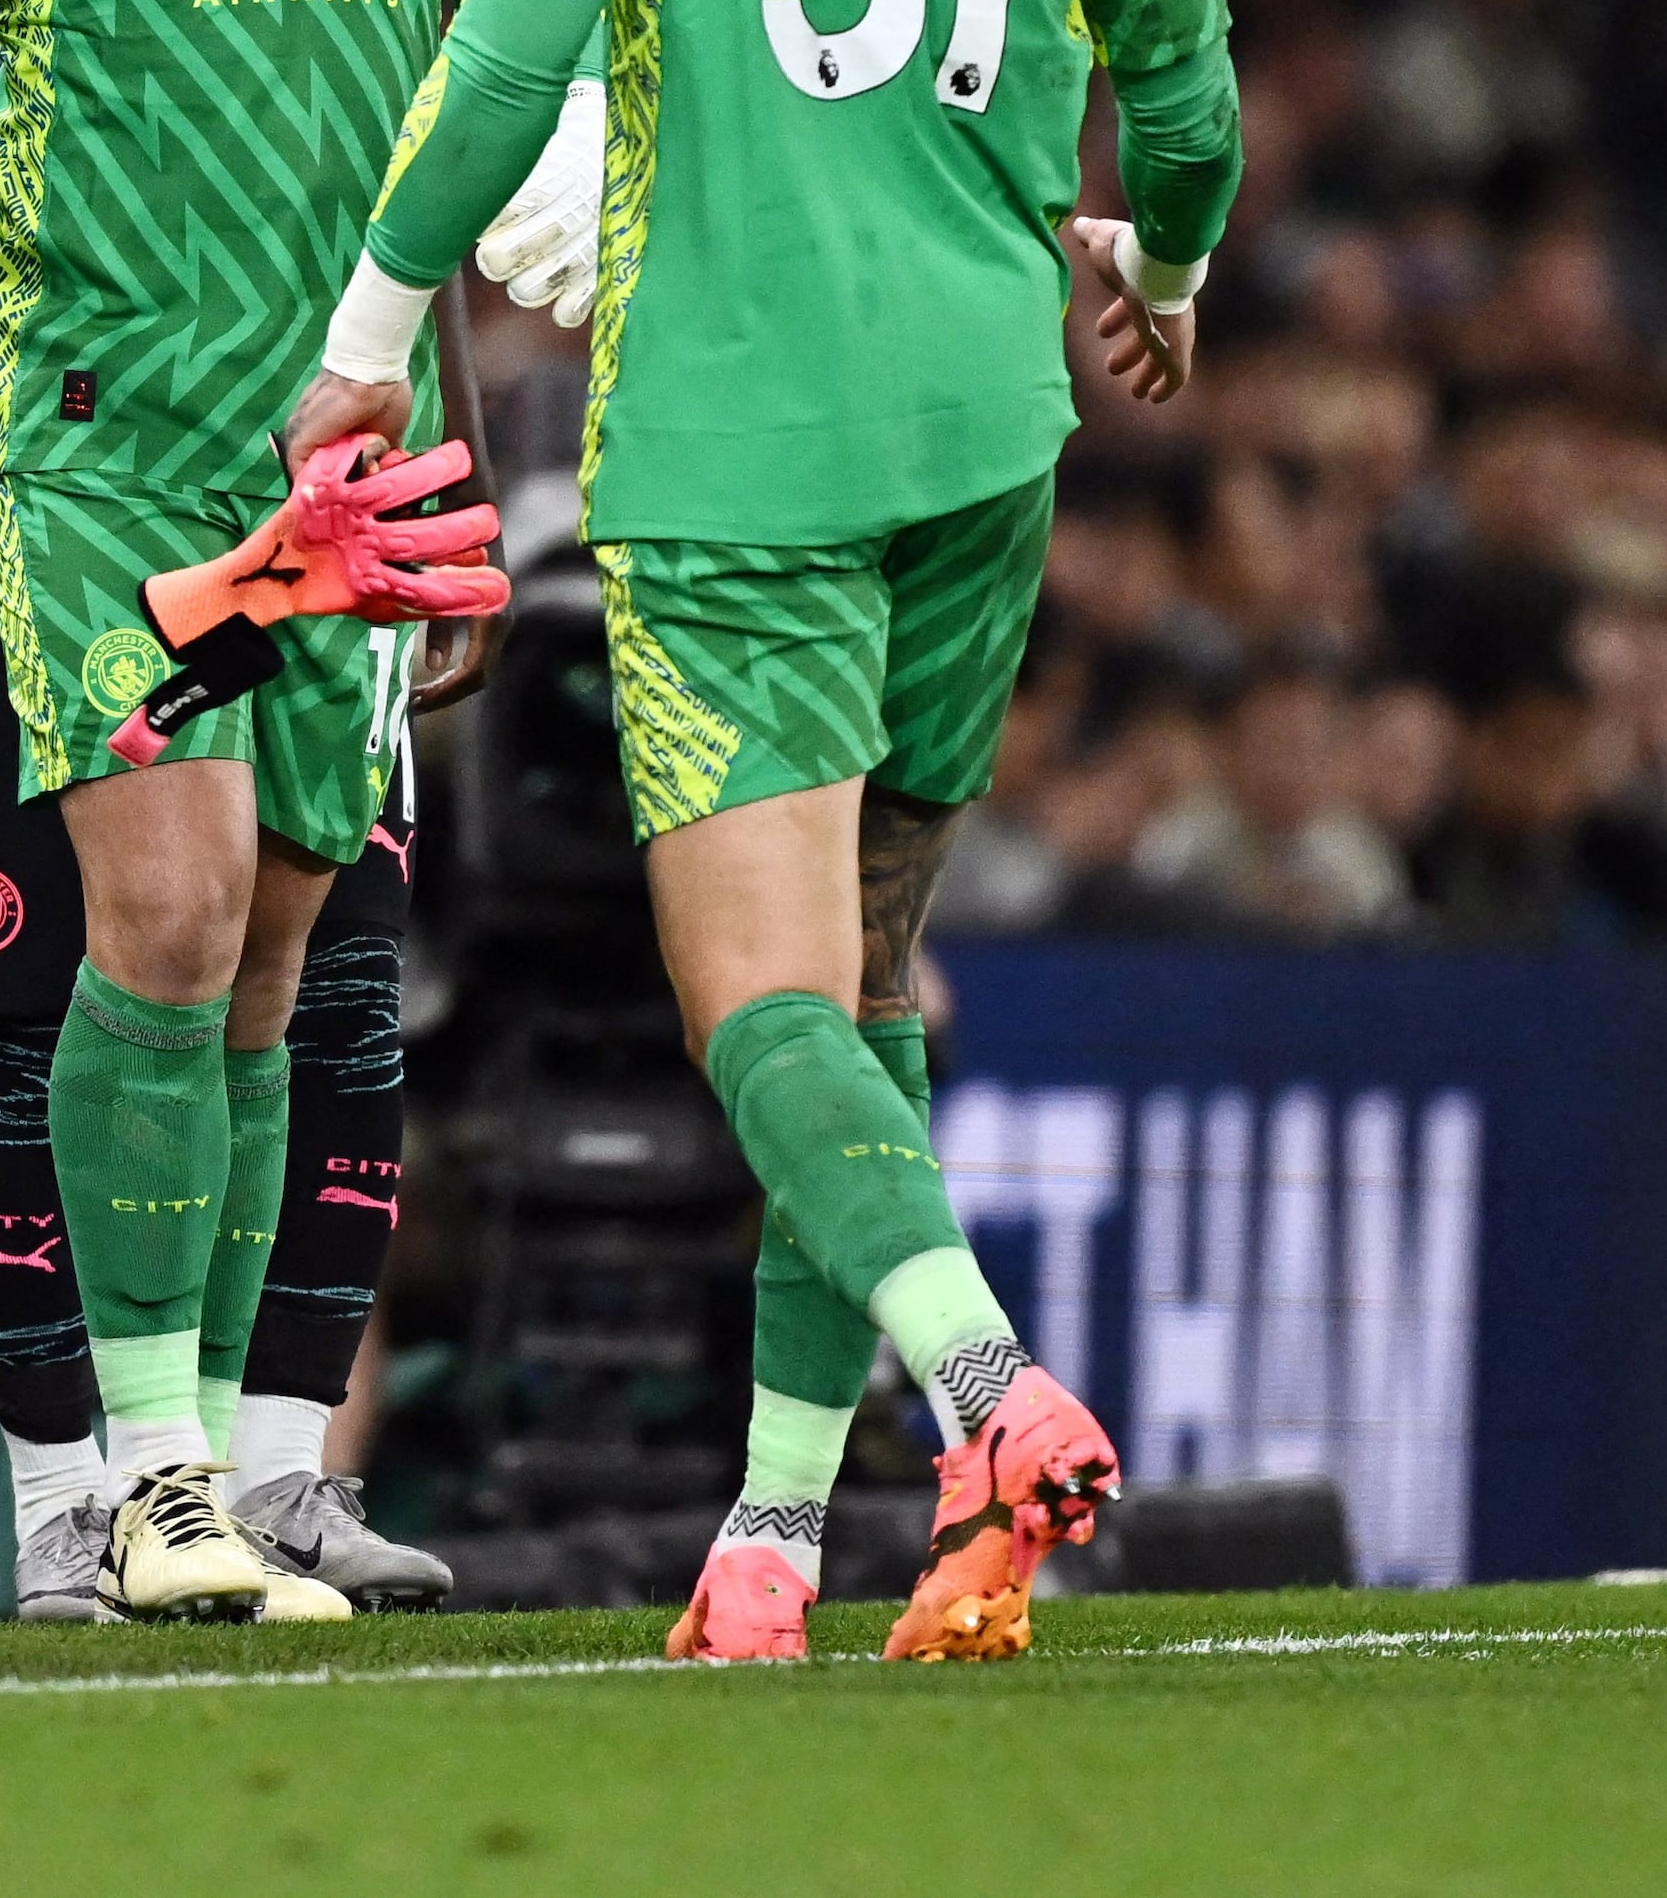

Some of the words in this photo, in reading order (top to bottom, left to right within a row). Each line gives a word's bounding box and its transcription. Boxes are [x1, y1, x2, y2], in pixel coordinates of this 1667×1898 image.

[89, 635, 157, 670] MANCHESTER
[111, 1195, 210, 1213] CITY
[216, 1228, 276, 1245] ITY
